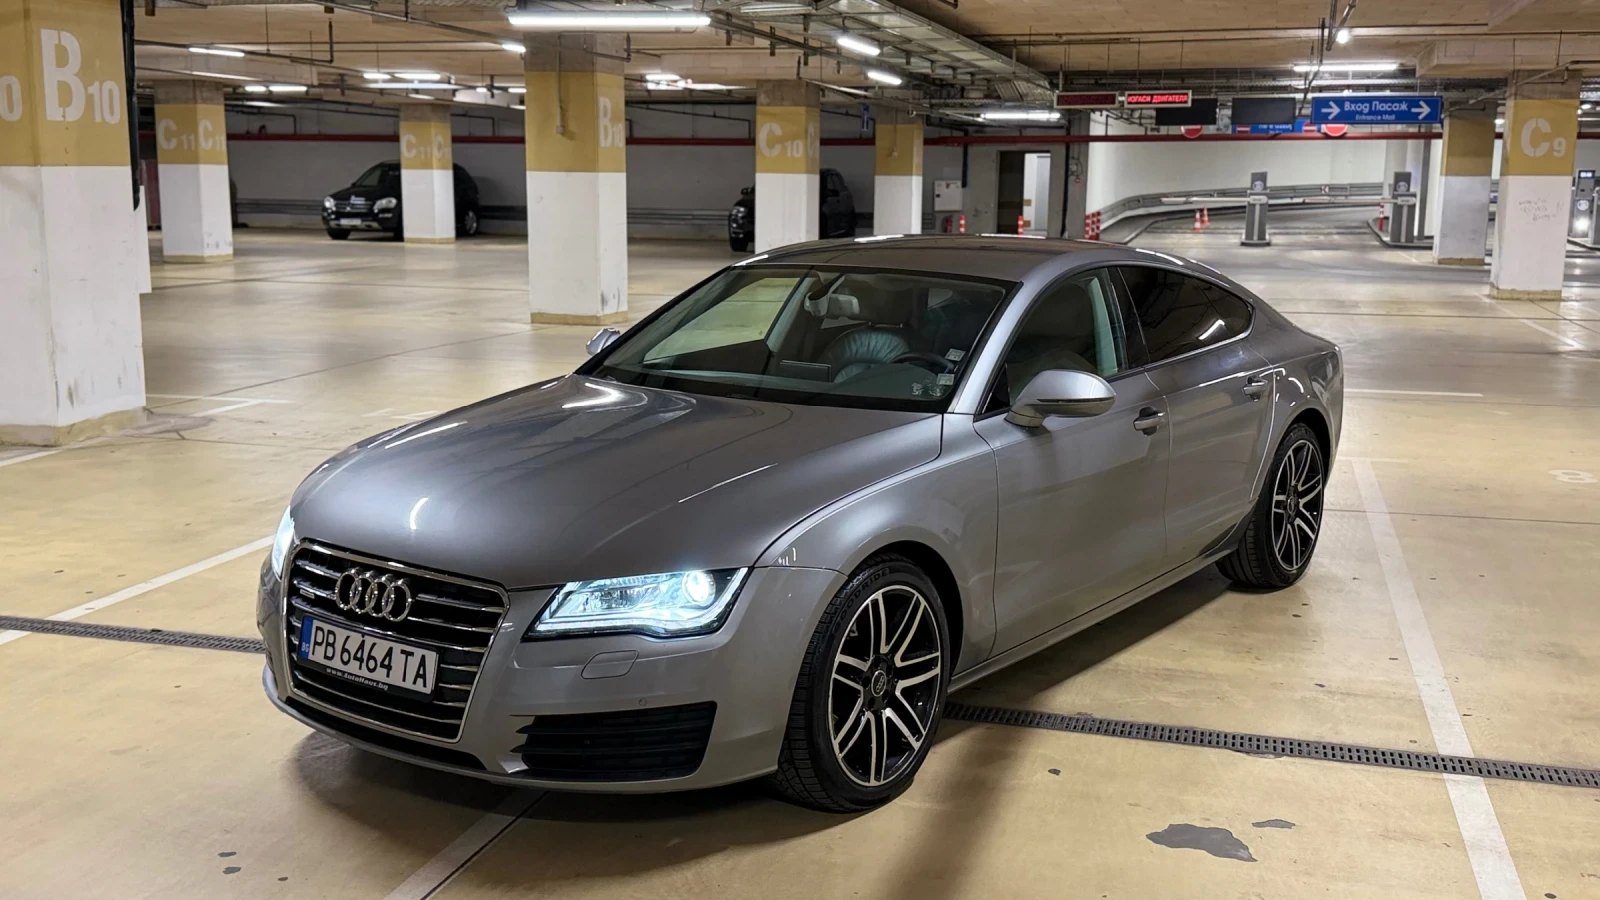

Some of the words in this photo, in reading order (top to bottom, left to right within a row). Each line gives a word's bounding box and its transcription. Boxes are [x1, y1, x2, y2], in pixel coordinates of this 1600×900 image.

[1344, 101, 1369, 113] Вход
[1372, 101, 1408, 111] Пасаж
[301, 642, 310, 653] BG
[326, 667, 389, 691] www.AutoHaus.bg
